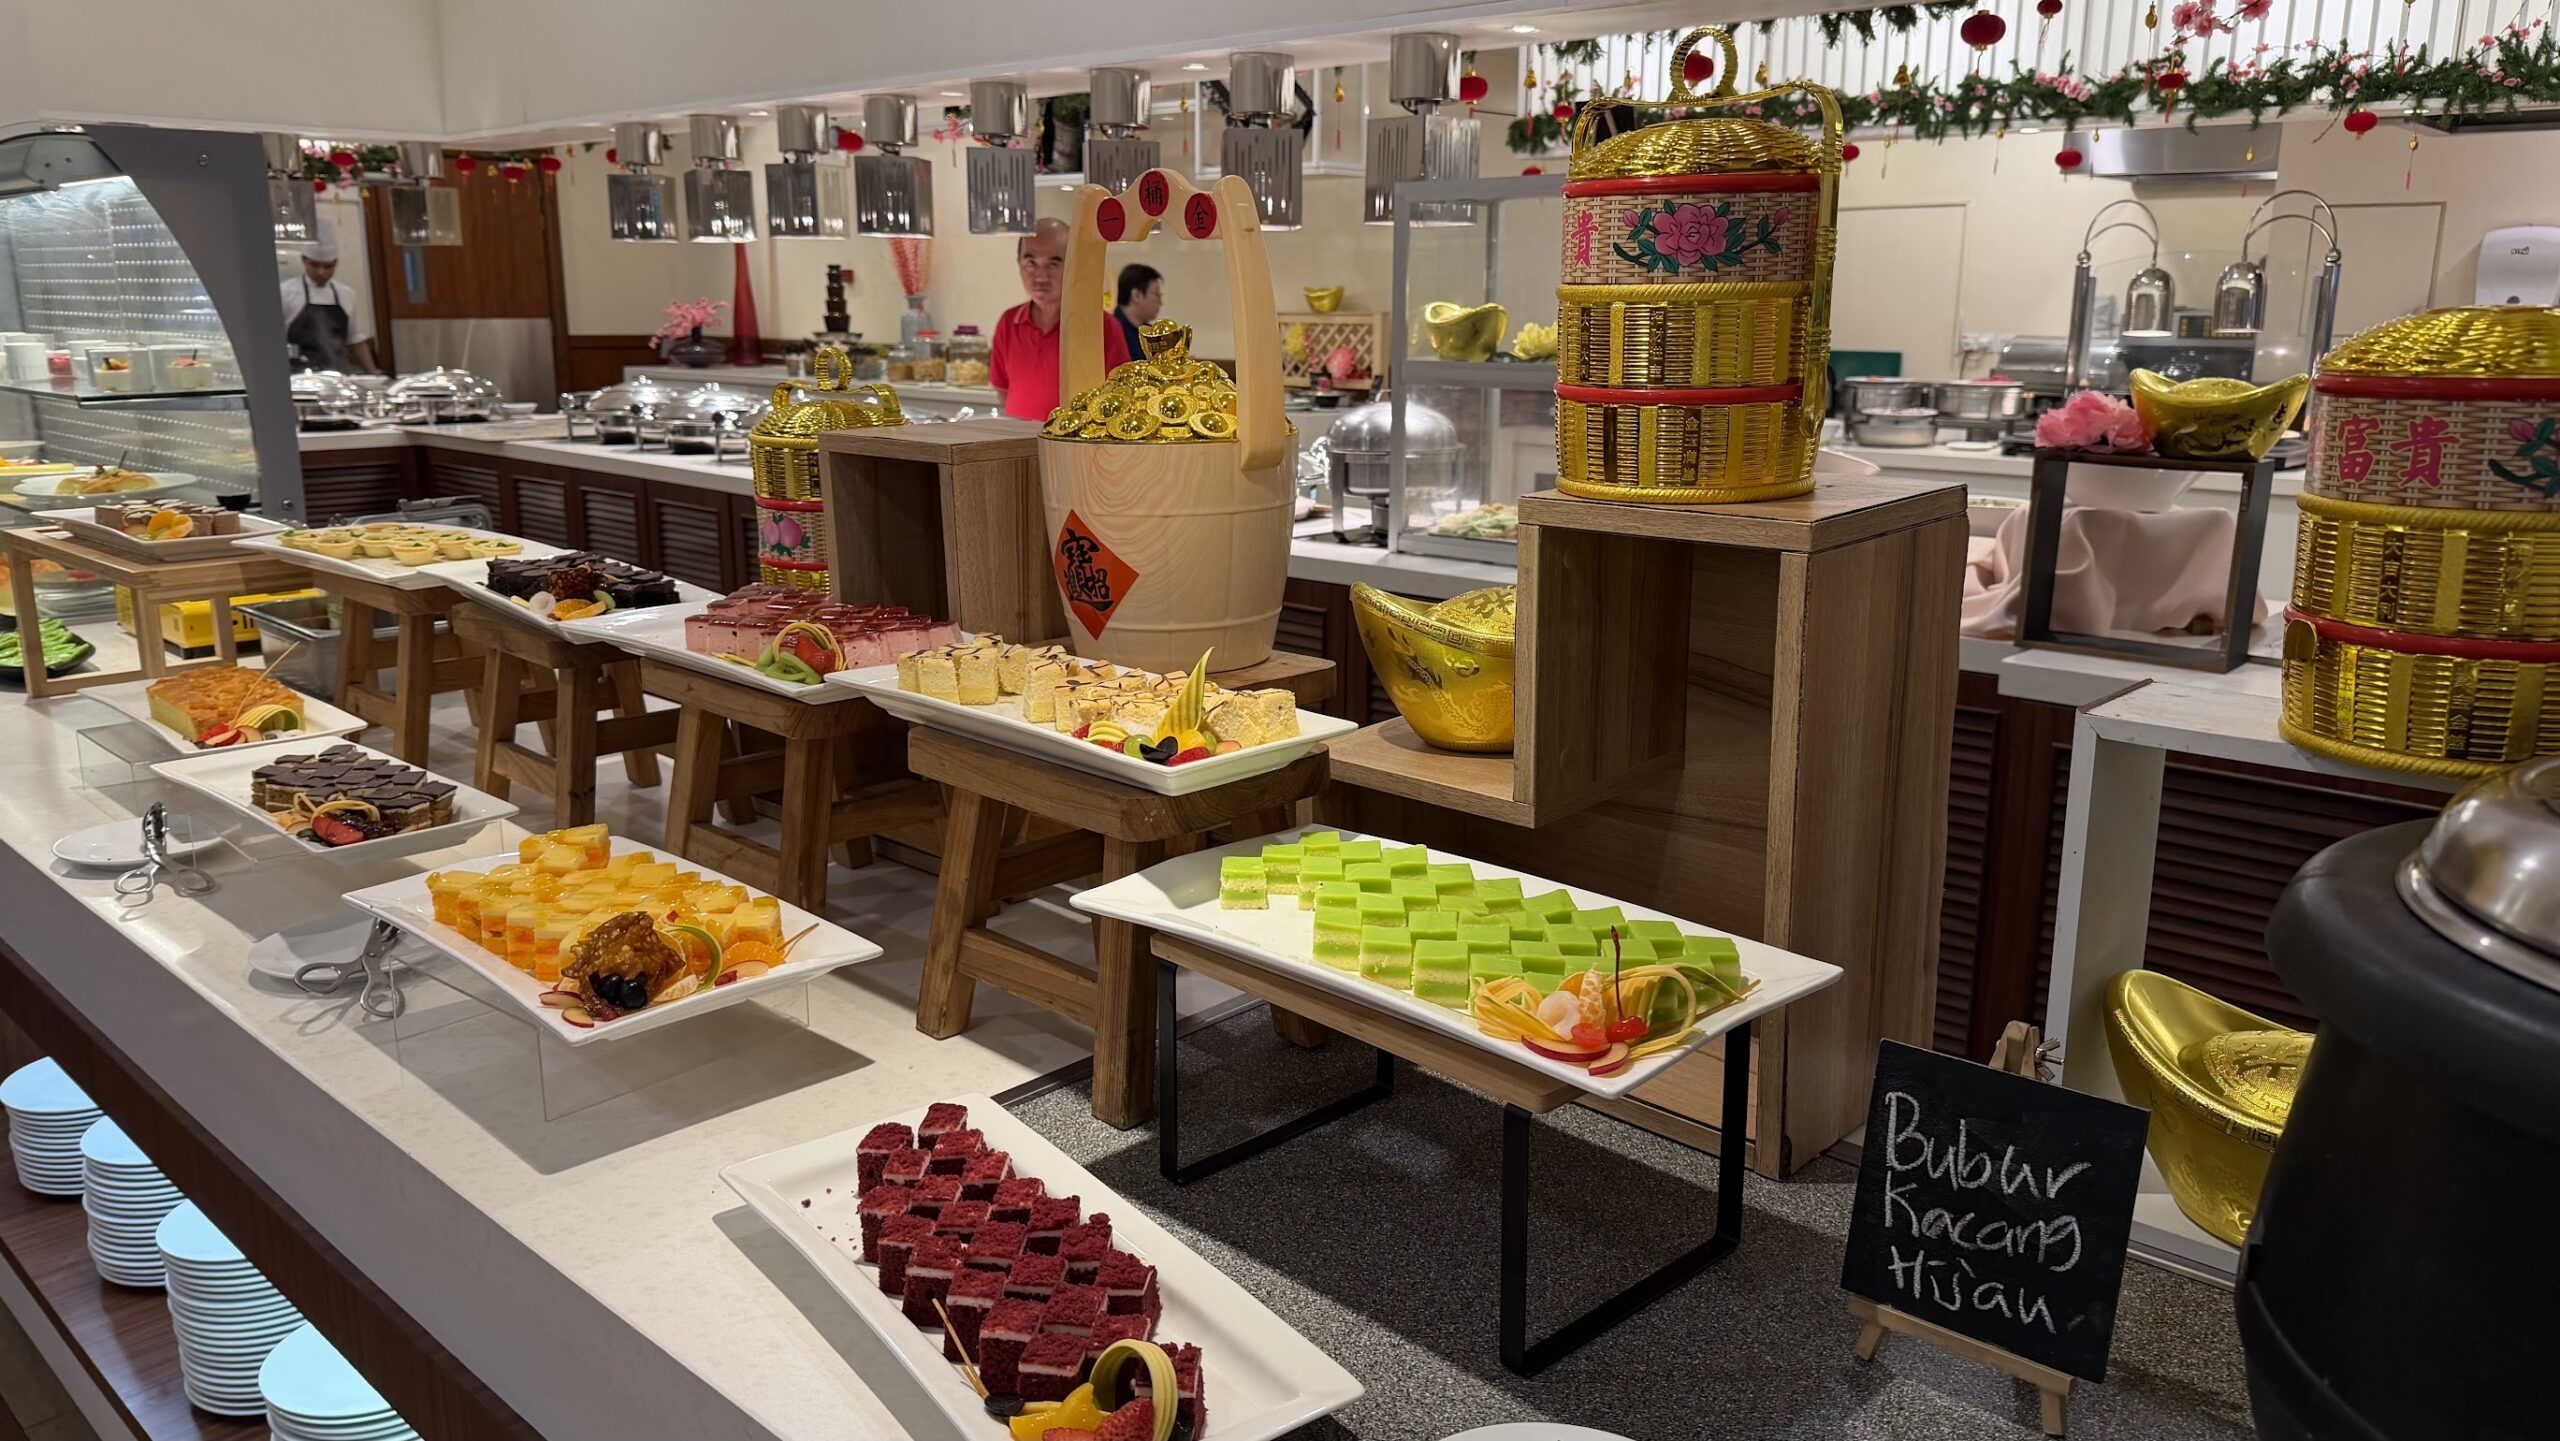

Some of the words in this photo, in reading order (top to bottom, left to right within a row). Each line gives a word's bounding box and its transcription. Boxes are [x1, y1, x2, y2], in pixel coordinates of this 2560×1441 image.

[2336, 413, 2461, 489] 富貴
[2378, 537, 2402, 621] 大吉大利
[1884, 1090, 2092, 1200] Bubur
[1884, 1170, 2083, 1274] Kacang
[1887, 1244, 2058, 1335] Hijau
